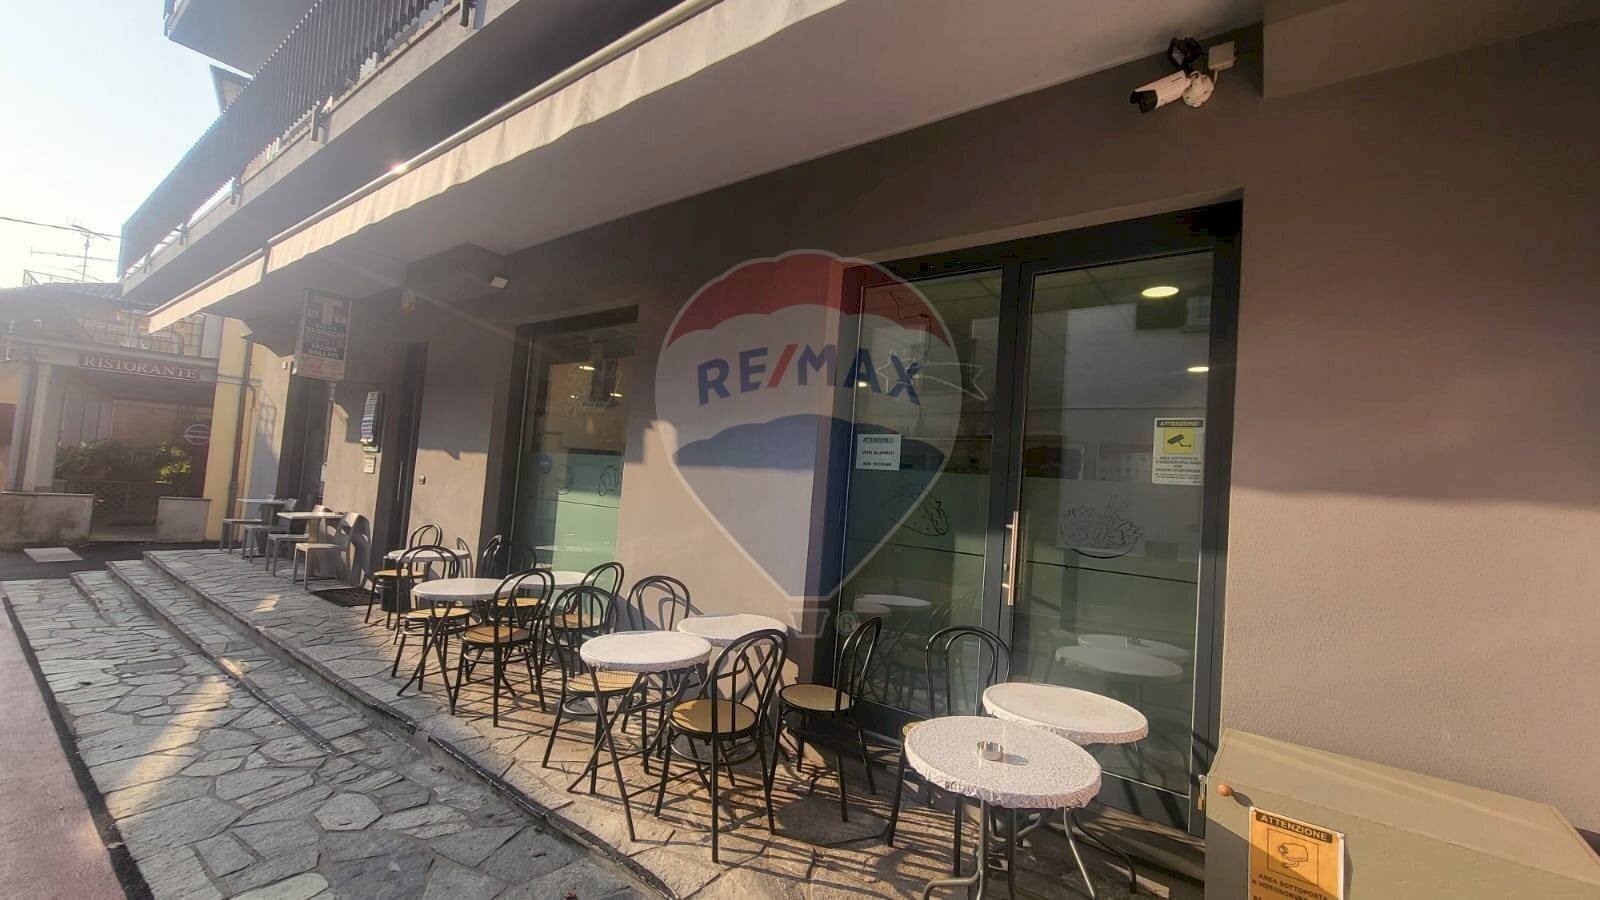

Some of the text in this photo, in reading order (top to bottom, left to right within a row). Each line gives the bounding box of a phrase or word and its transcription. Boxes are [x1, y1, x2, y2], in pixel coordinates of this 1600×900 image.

[84, 356, 199, 380] RISTORANTE
[1261, 814, 1329, 842] ATTENZIONE
[1257, 873, 1278, 885] AREA
